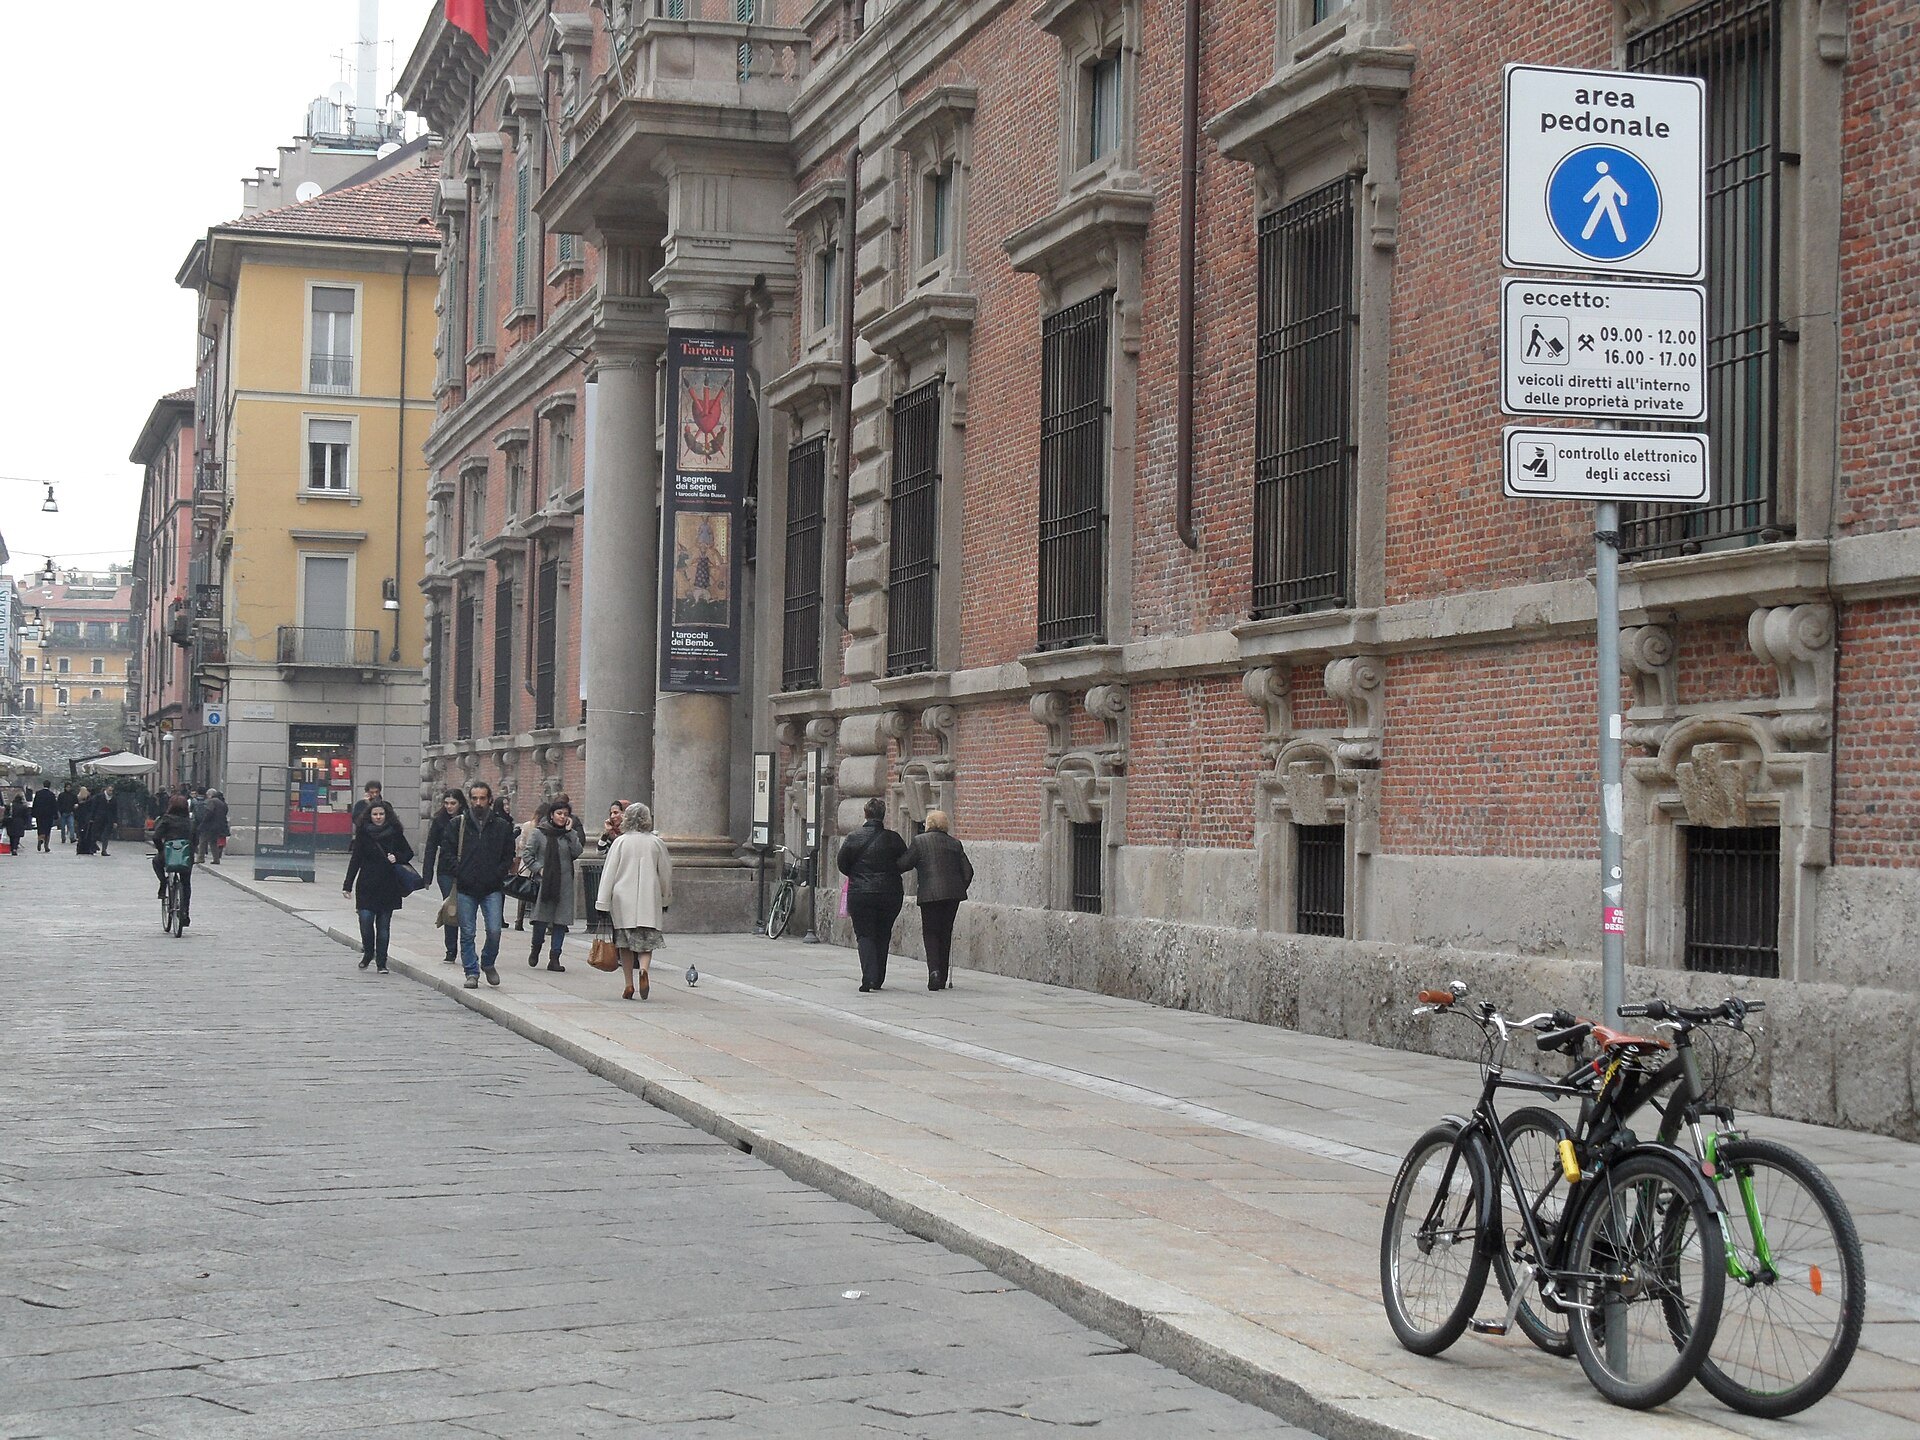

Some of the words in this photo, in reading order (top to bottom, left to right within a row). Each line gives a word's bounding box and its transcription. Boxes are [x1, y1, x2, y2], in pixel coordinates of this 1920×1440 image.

[1574, 88, 1635, 109] area
[1541, 111, 1670, 138] pedonale
[1523, 291, 1610, 308] eccetto:
[1600, 326, 1643, 343] 09.00
[1658, 329, 1696, 345] 12.00
[680, 343, 734, 357] Tarocchi
[1604, 349, 1644, 365] 16.00
[1659, 352, 1697, 368] 17.00
[1517, 373, 1563, 387] veicoli
[1568, 375, 1612, 389] diretti
[1617, 377, 1690, 392] all'interno
[1525, 392, 1560, 405] delle
[1564, 394, 1629, 410] proprietà
[1634, 397, 1684, 411] private
[1558, 447, 1619, 461] controllo
[1624, 449, 1697, 463] elettronico
[675, 474, 681, 482] Il
[682, 475, 713, 484] segreto
[1586, 467, 1619, 483] degli
[1623, 469, 1671, 482] accessi
[689, 483, 717, 492] segreti
[671, 638, 684, 646] dei
[685, 638, 714, 647] Bembo
[675, 631, 709, 639] tarocchi
